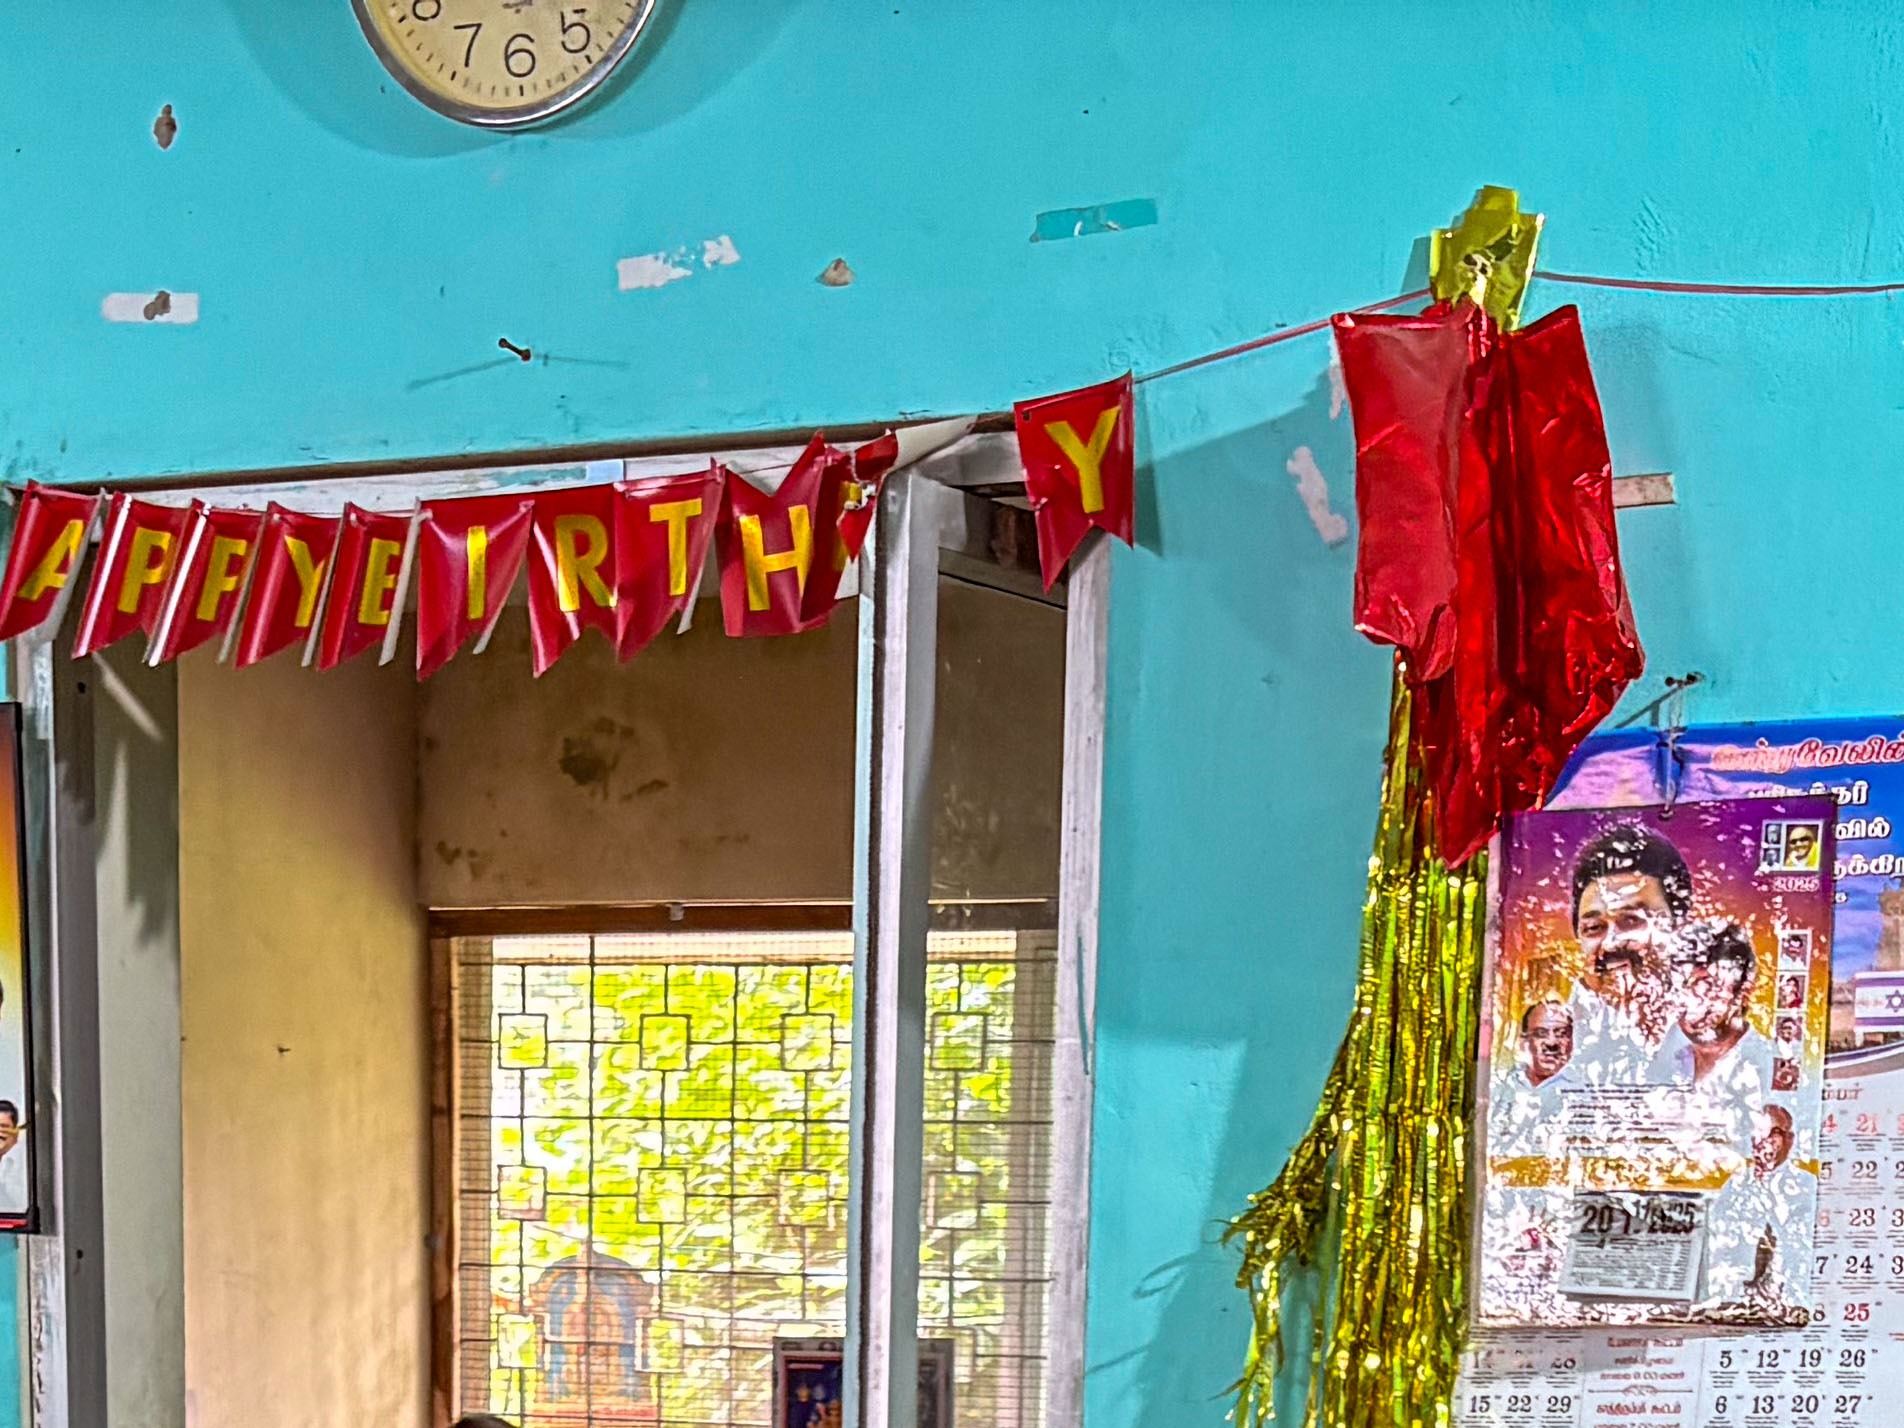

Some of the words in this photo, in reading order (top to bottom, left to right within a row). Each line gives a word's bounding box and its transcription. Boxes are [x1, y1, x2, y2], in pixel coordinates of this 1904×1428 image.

[560, 10, 591, 54] 5
[454, 23, 482, 67] 7
[504, 34, 536, 77] 6
[1852, 1160, 1878, 1179] 22
[1848, 1208, 1875, 1227] 23
[1845, 1255, 1873, 1274] 24
[1843, 1303, 1870, 1322] 25
[1719, 1350, 1733, 1369] 5
[1756, 1349, 1780, 1368] 12
[1799, 1349, 1822, 1368] 19
[1840, 1349, 1865, 1368] 26
[1470, 1395, 1490, 1413] 15
[1507, 1395, 1532, 1413] 22
[1547, 1395, 1571, 1414] 29
[1715, 1395, 1728, 1413] 6
[1752, 1395, 1775, 1413] 13
[1790, 1395, 1819, 1413] 20
[1834, 1395, 1861, 1414] 27
